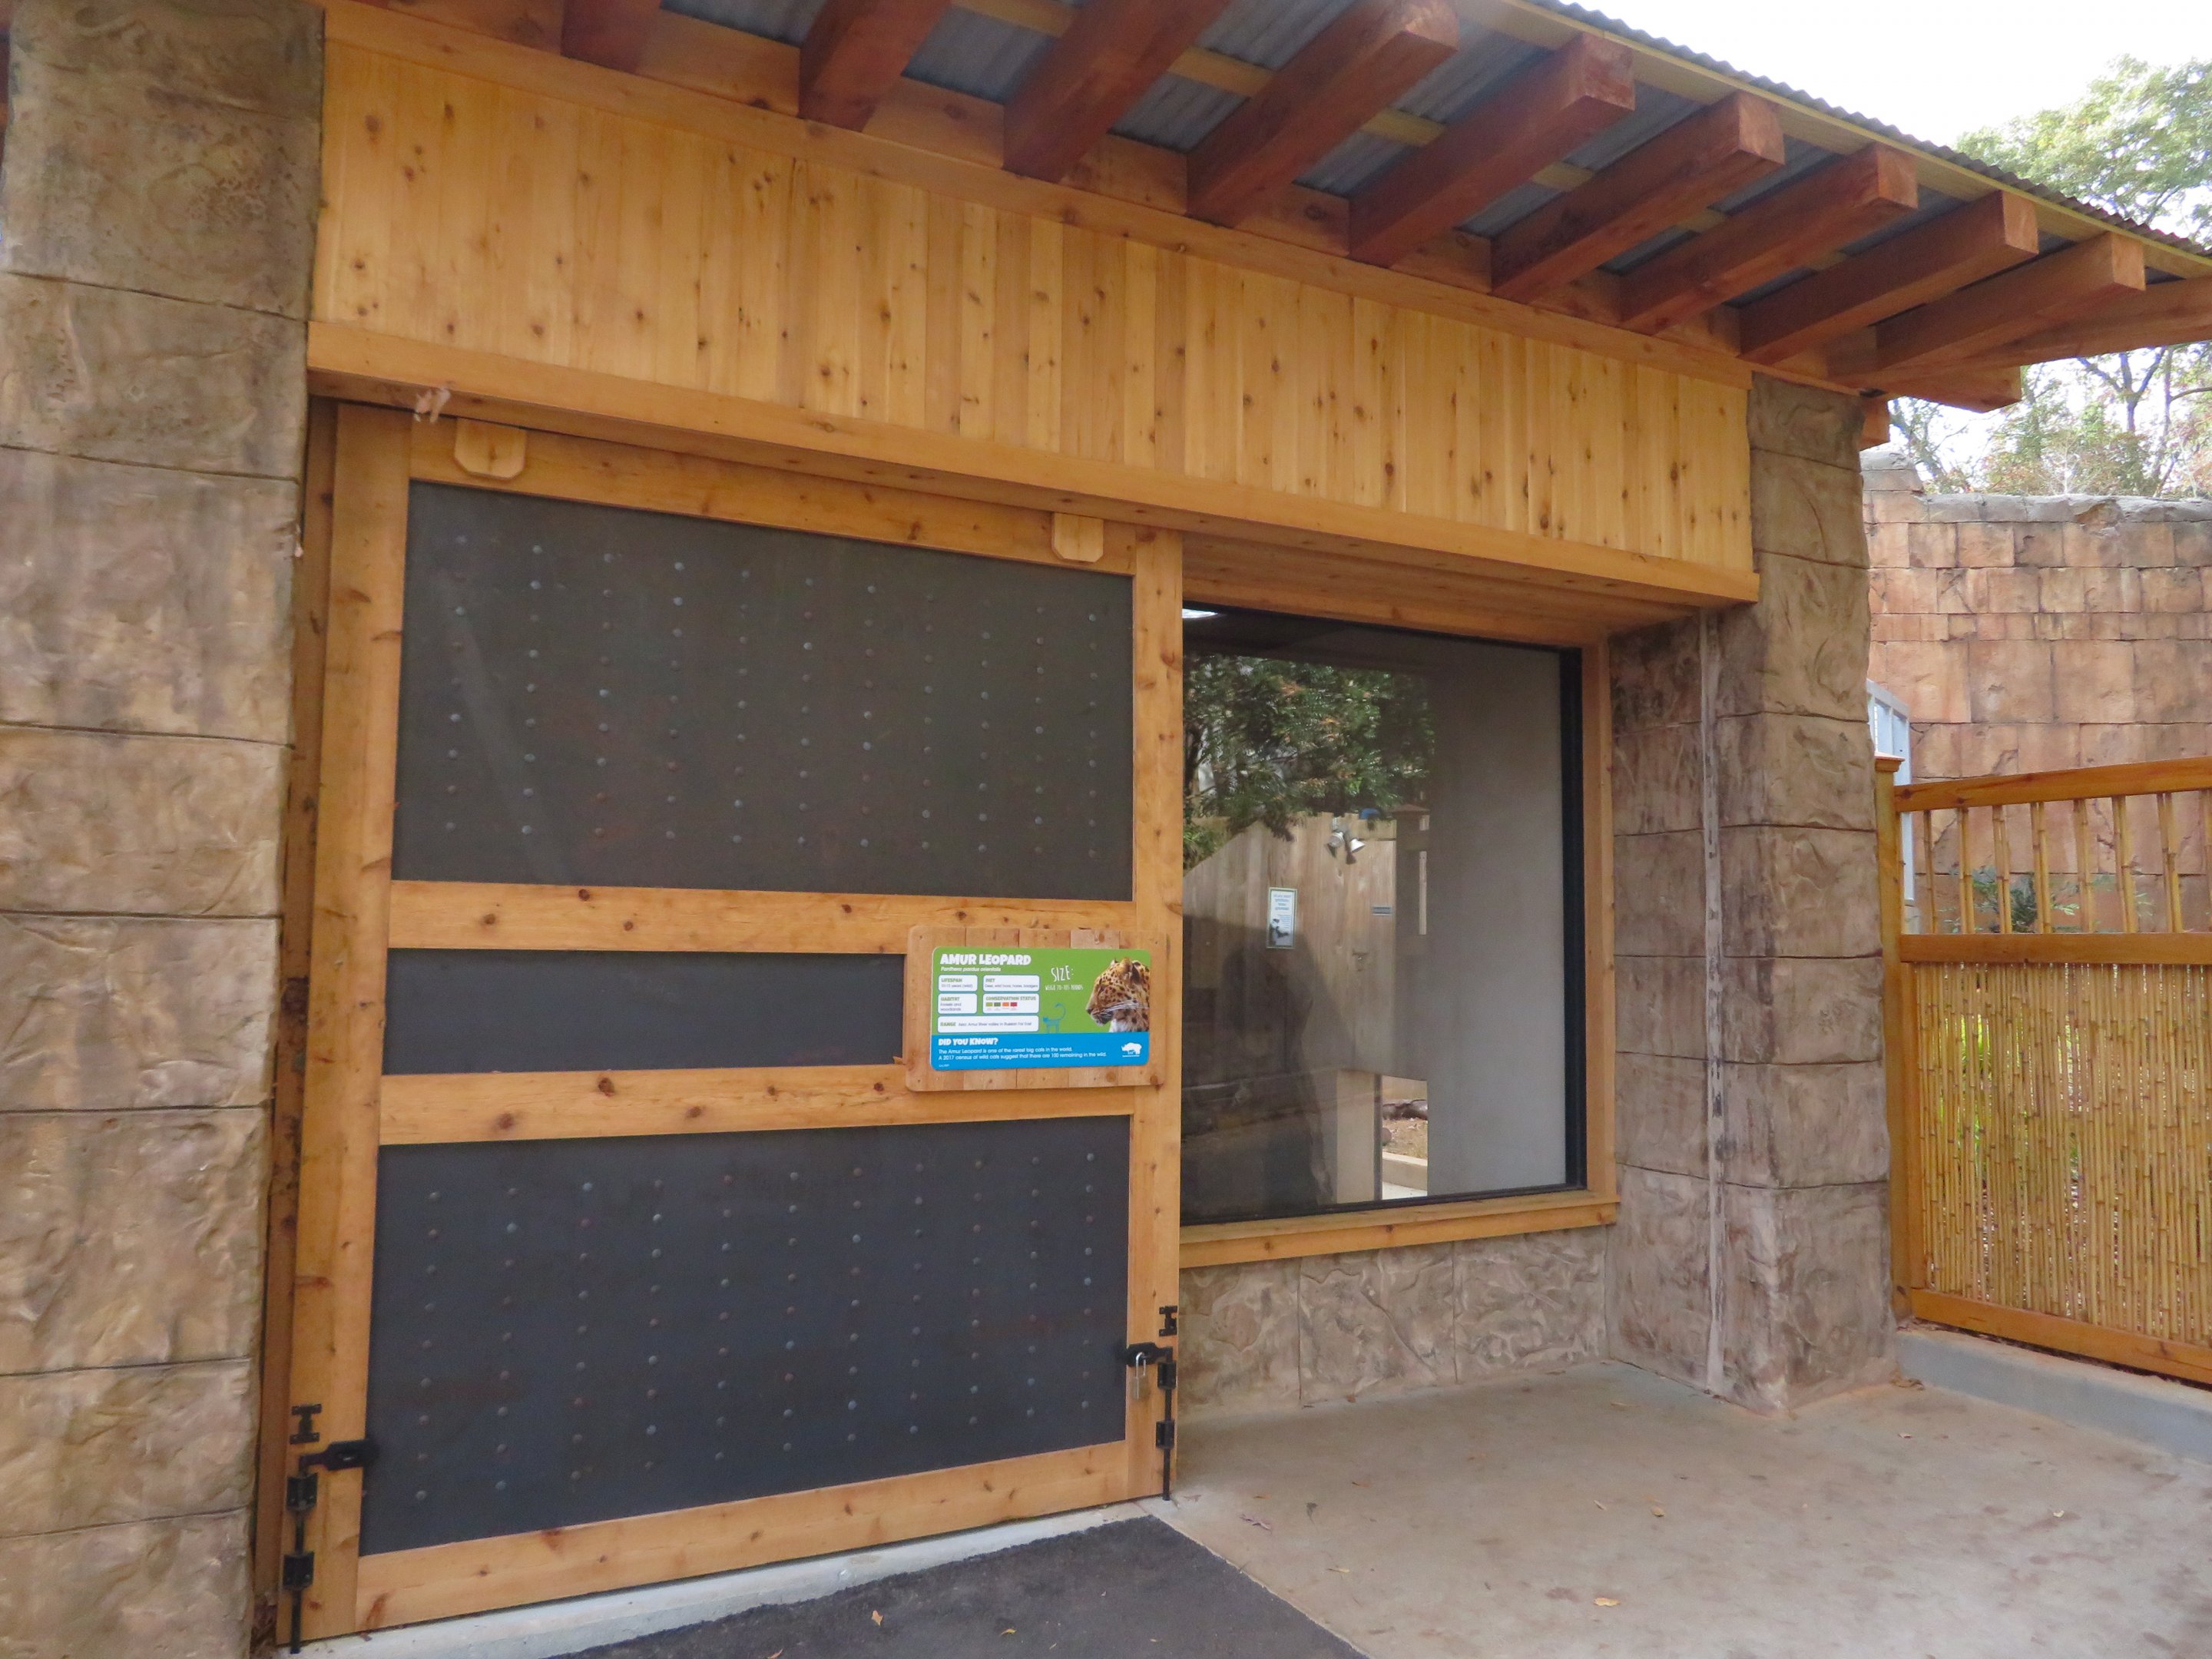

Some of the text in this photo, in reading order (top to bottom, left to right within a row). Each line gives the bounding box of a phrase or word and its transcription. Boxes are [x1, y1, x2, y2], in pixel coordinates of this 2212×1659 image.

[940, 954, 1031, 965] AMUR LEOPARD
[1051, 965, 1074, 982] SIZE:
